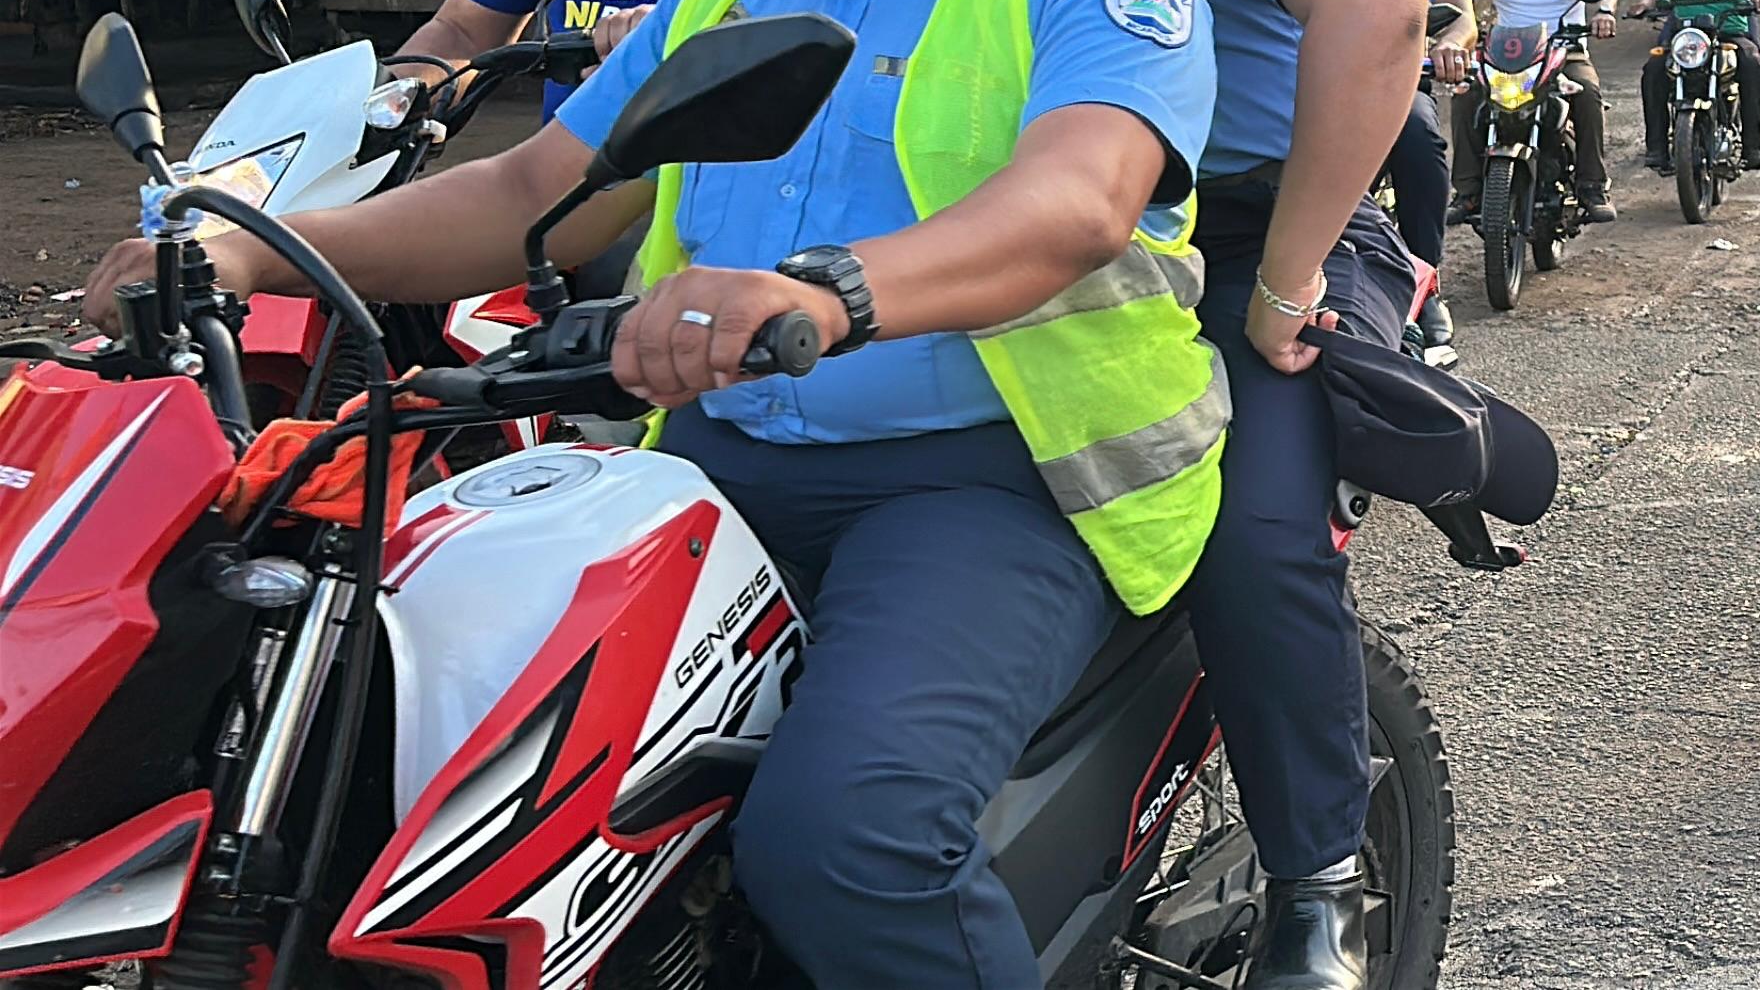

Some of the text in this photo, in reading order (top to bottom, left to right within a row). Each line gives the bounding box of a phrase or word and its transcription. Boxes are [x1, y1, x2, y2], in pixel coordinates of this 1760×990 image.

[564, 0, 601, 29] NI
[1504, 38, 1523, 59] 9
[674, 563, 771, 689] GENESIS
